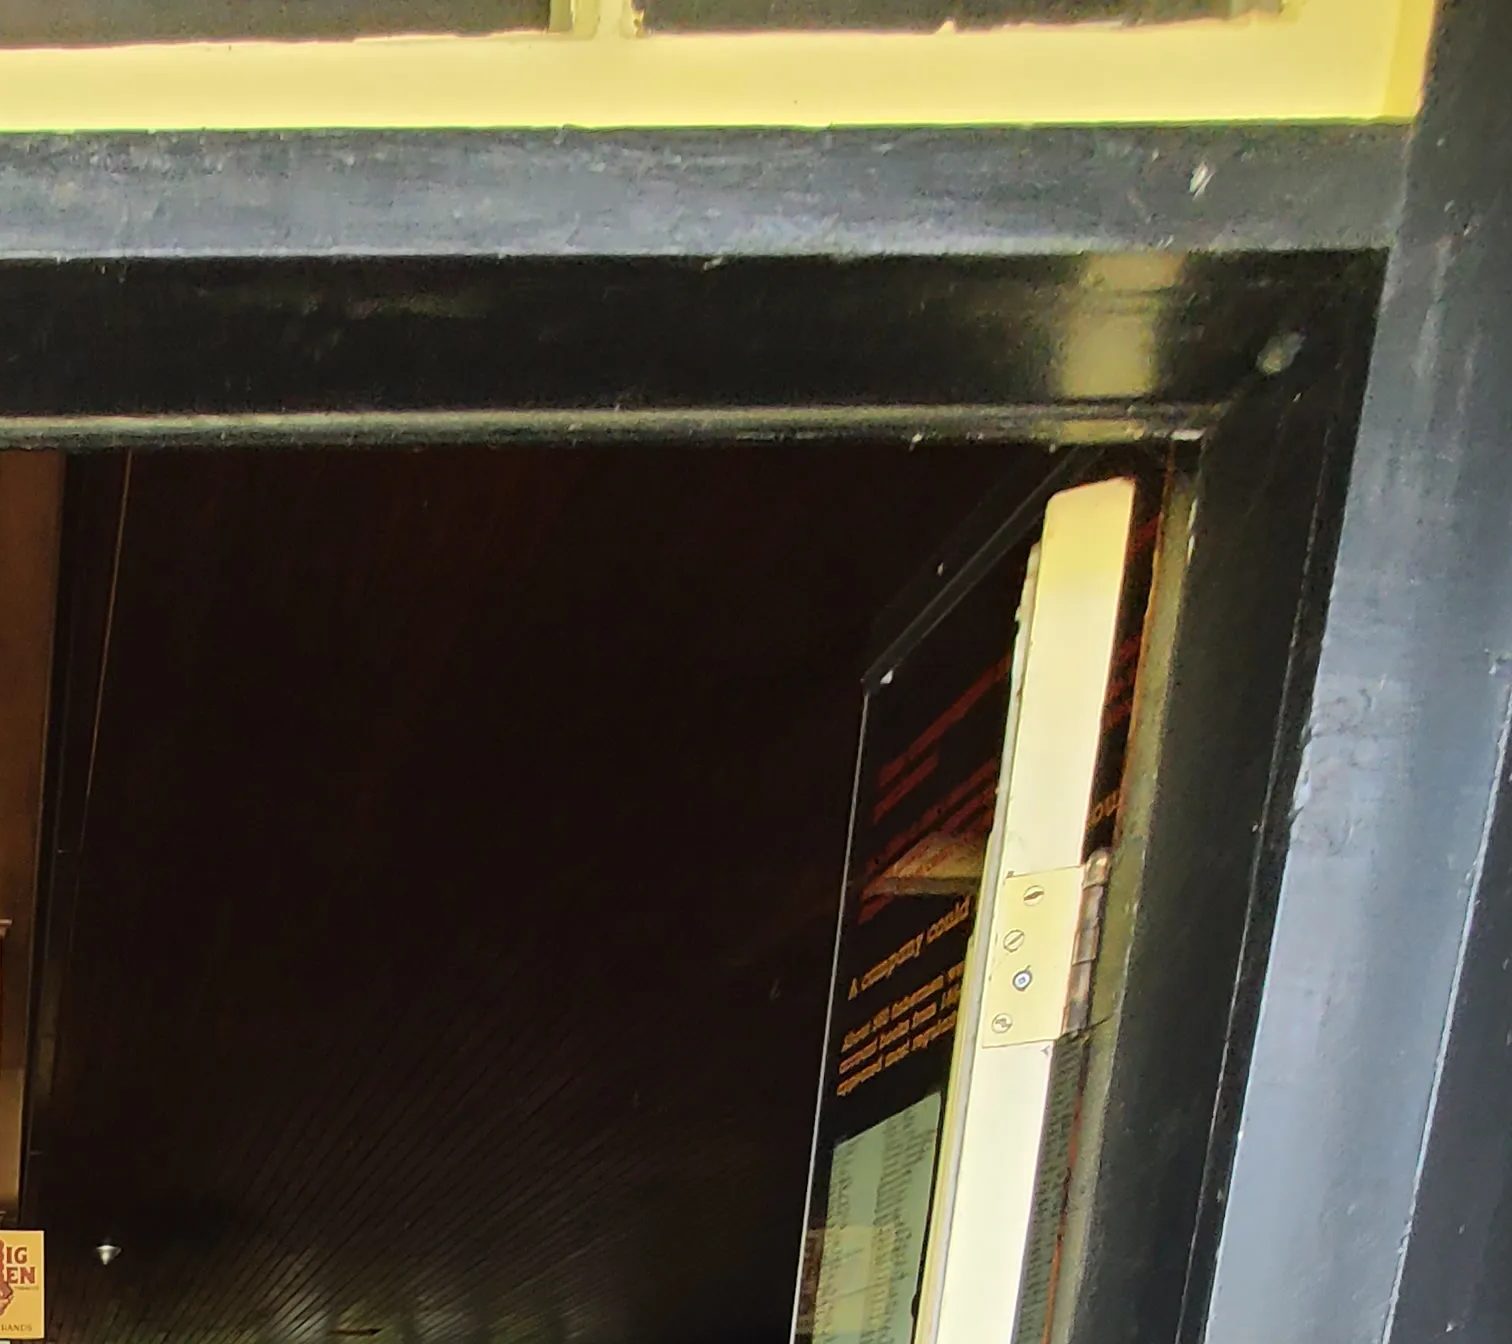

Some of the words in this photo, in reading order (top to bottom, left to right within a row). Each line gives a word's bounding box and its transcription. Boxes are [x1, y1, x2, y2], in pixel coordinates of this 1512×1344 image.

[861, 932, 925, 991] company
[927, 894, 972, 944] could
[6, 1246, 28, 1265] IG
[6, 1266, 36, 1284] EN
